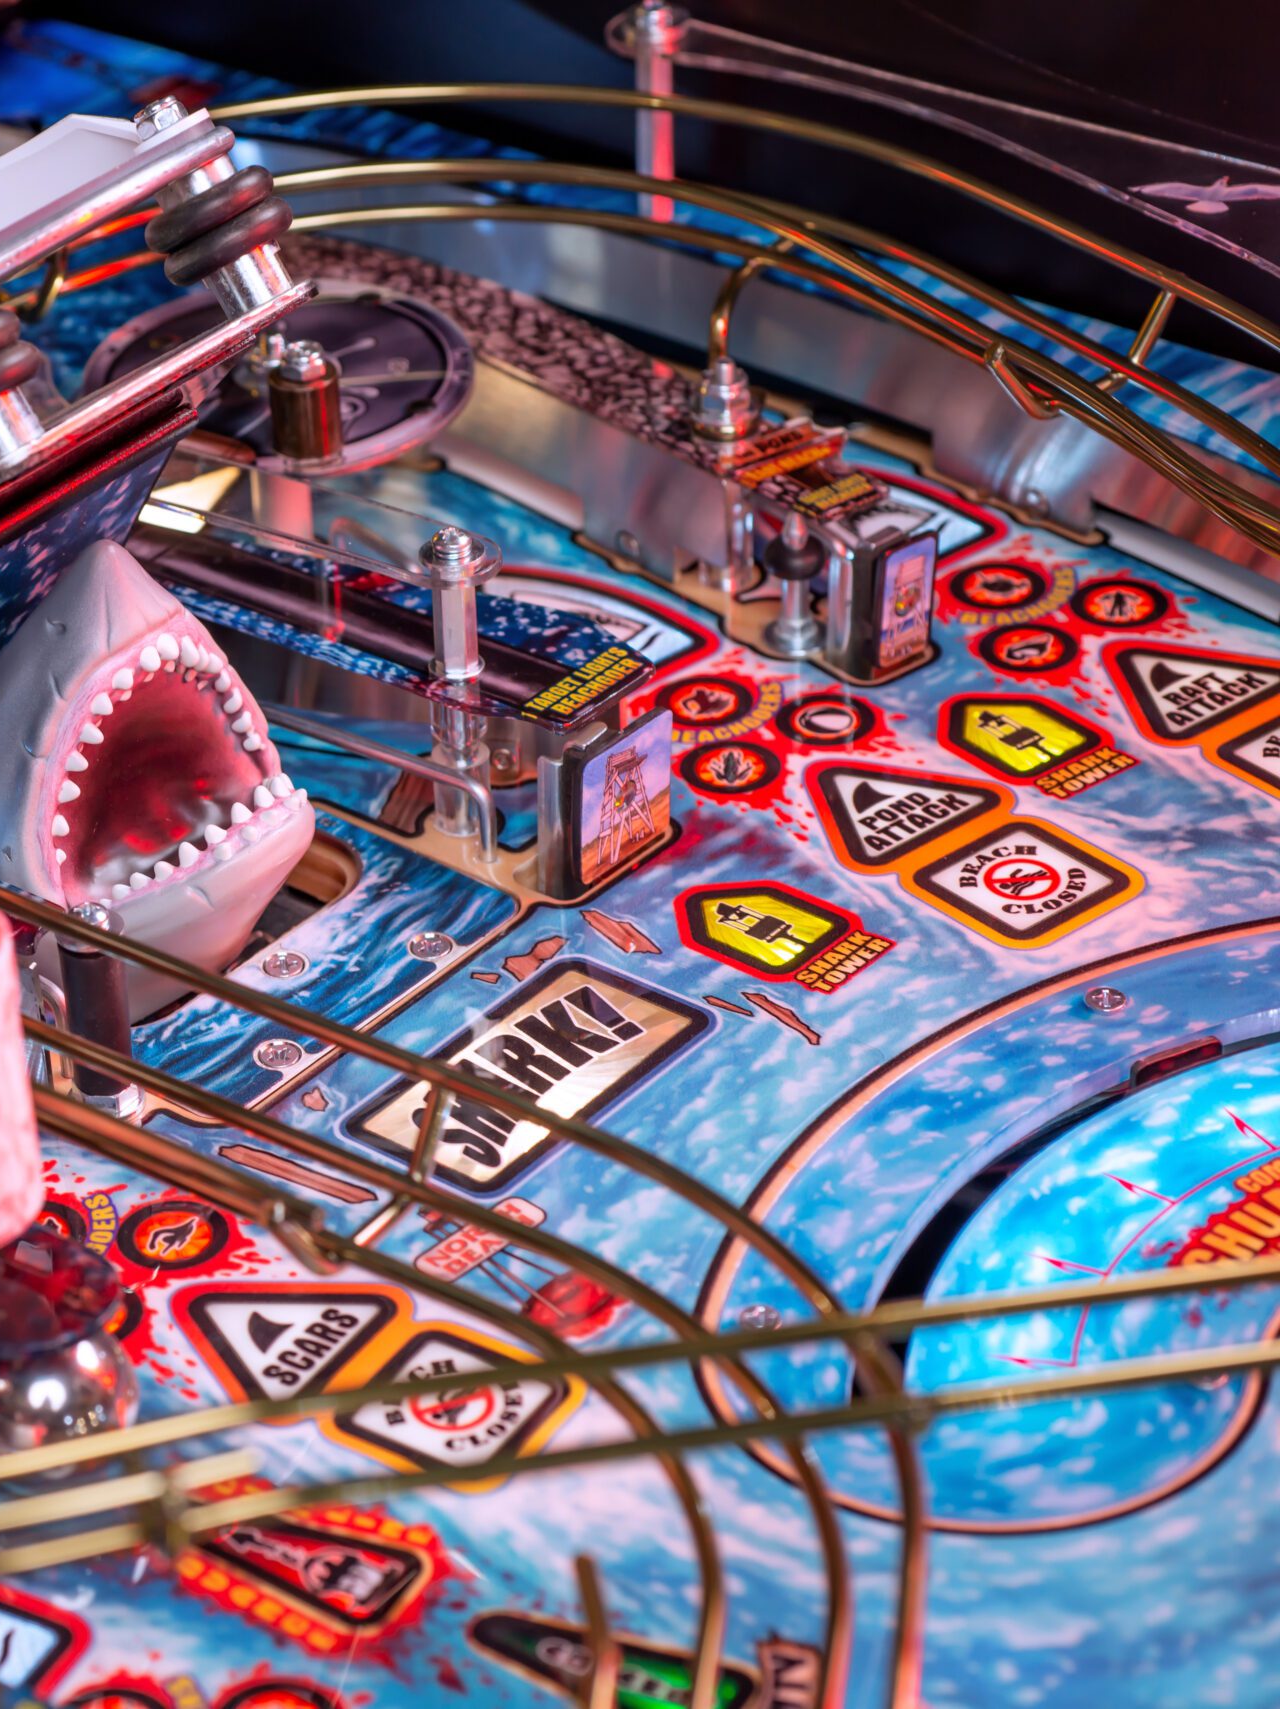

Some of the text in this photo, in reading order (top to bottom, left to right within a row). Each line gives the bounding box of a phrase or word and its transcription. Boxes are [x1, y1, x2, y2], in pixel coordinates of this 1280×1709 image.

[524, 646, 630, 712] TARGET LIGHTS
[550, 657, 645, 716] BEACHGOER
[1161, 671, 1227, 706] RAFT
[1165, 670, 1269, 727] ATTACK
[1034, 746, 1121, 788] SHARK
[1047, 753, 1137, 798] TOWER
[857, 791, 932, 831] POND
[862, 793, 971, 852] ATTACK
[958, 844, 1039, 889] BEACH
[1001, 867, 1088, 915] CLOSED
[795, 930, 873, 984] SHARK
[810, 937, 892, 992] TOWER
[424, 1202, 524, 1268] NORH
[262, 1307, 360, 1387] SCARS
[384, 1358, 459, 1426] BCH
[444, 1379, 524, 1450] CLOSE
